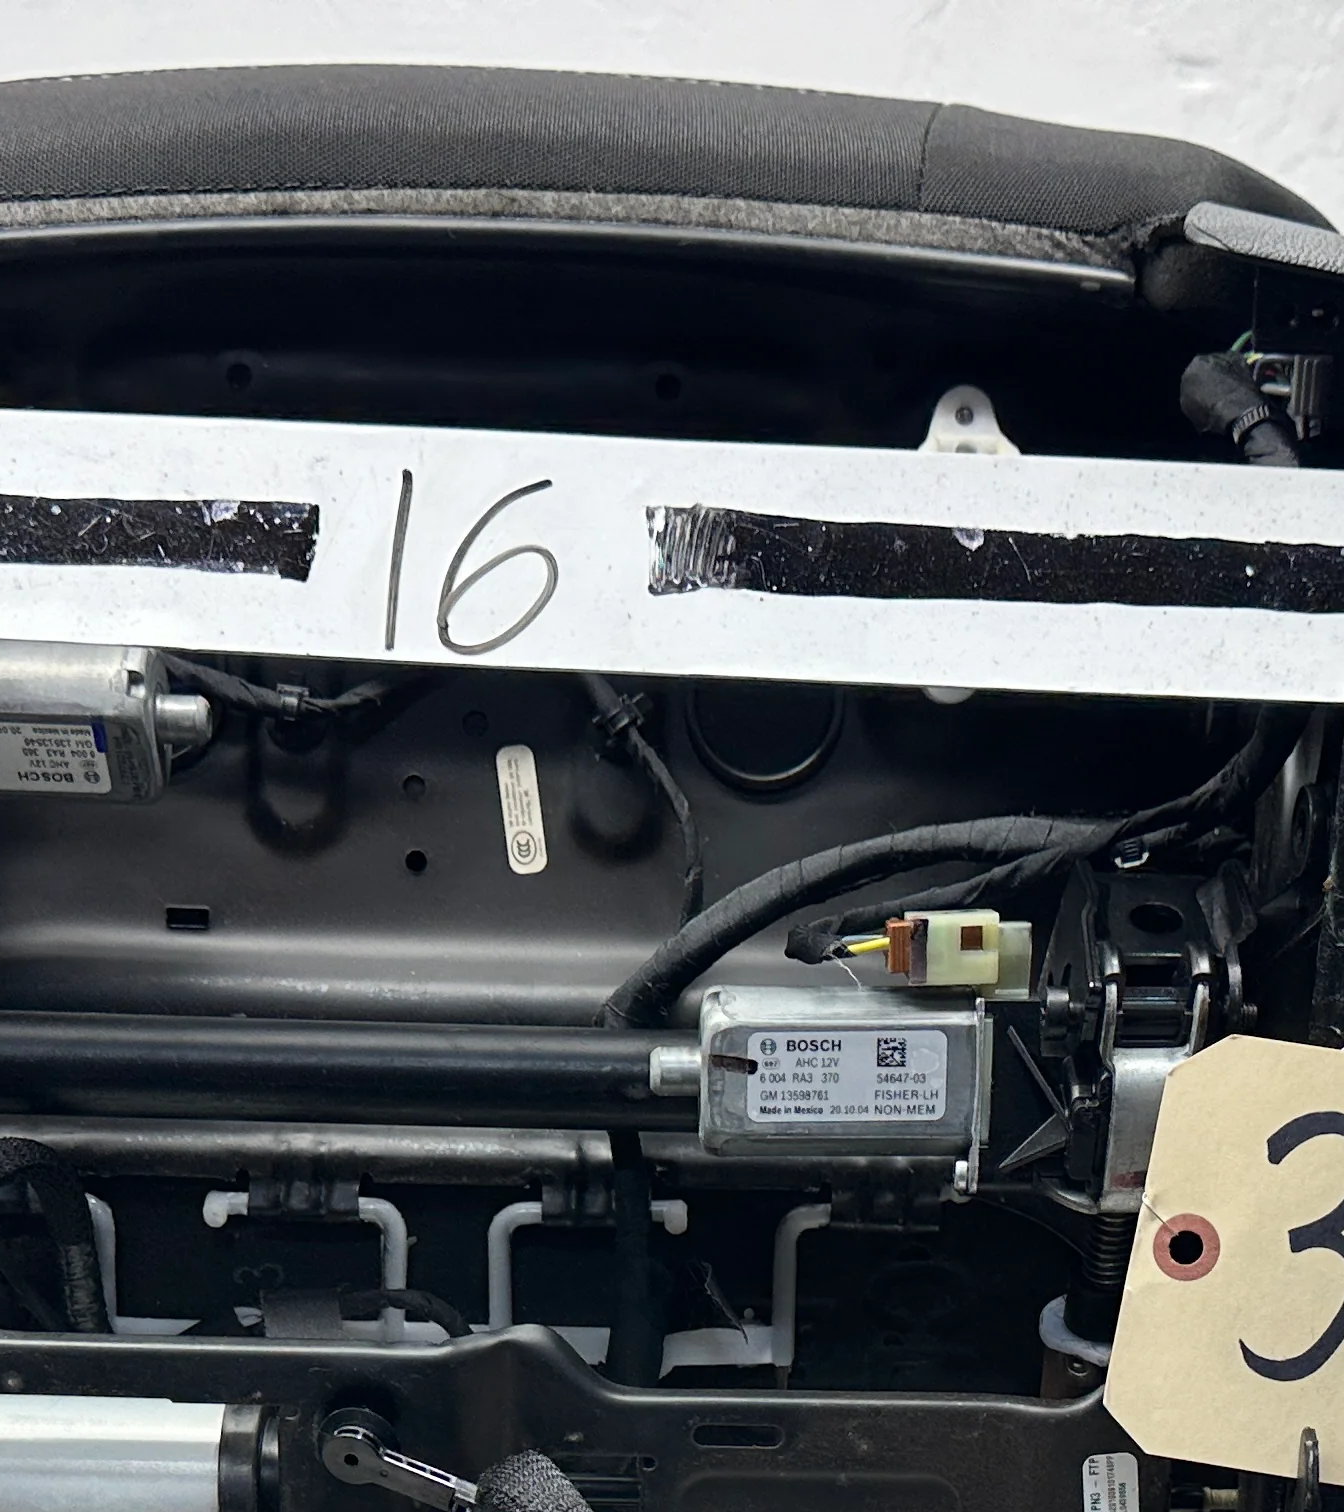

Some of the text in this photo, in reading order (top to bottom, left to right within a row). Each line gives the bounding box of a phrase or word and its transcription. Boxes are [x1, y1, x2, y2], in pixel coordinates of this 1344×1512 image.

[384, 468, 558, 655] 16
[17, 771, 74, 783] BOSCH
[786, 1039, 842, 1052] BOSCH
[795, 1057, 840, 1068] AHC 12V
[768, 1072, 786, 1083] 004
[792, 1072, 813, 1083] RA3
[821, 1072, 840, 1083] 370
[876, 1073, 926, 1084] 54647-03
[760, 1090, 777, 1101] GM
[874, 1089, 939, 1100] FISHER-LH
[759, 1105, 782, 1114] Made
[784, 1105, 792, 1114] in
[794, 1105, 824, 1114] Mexico
[874, 1104, 936, 1115] NON-MEM
[1088, 1457, 1100, 1476] FTP
[1090, 1492, 1101, 1511] PN3
